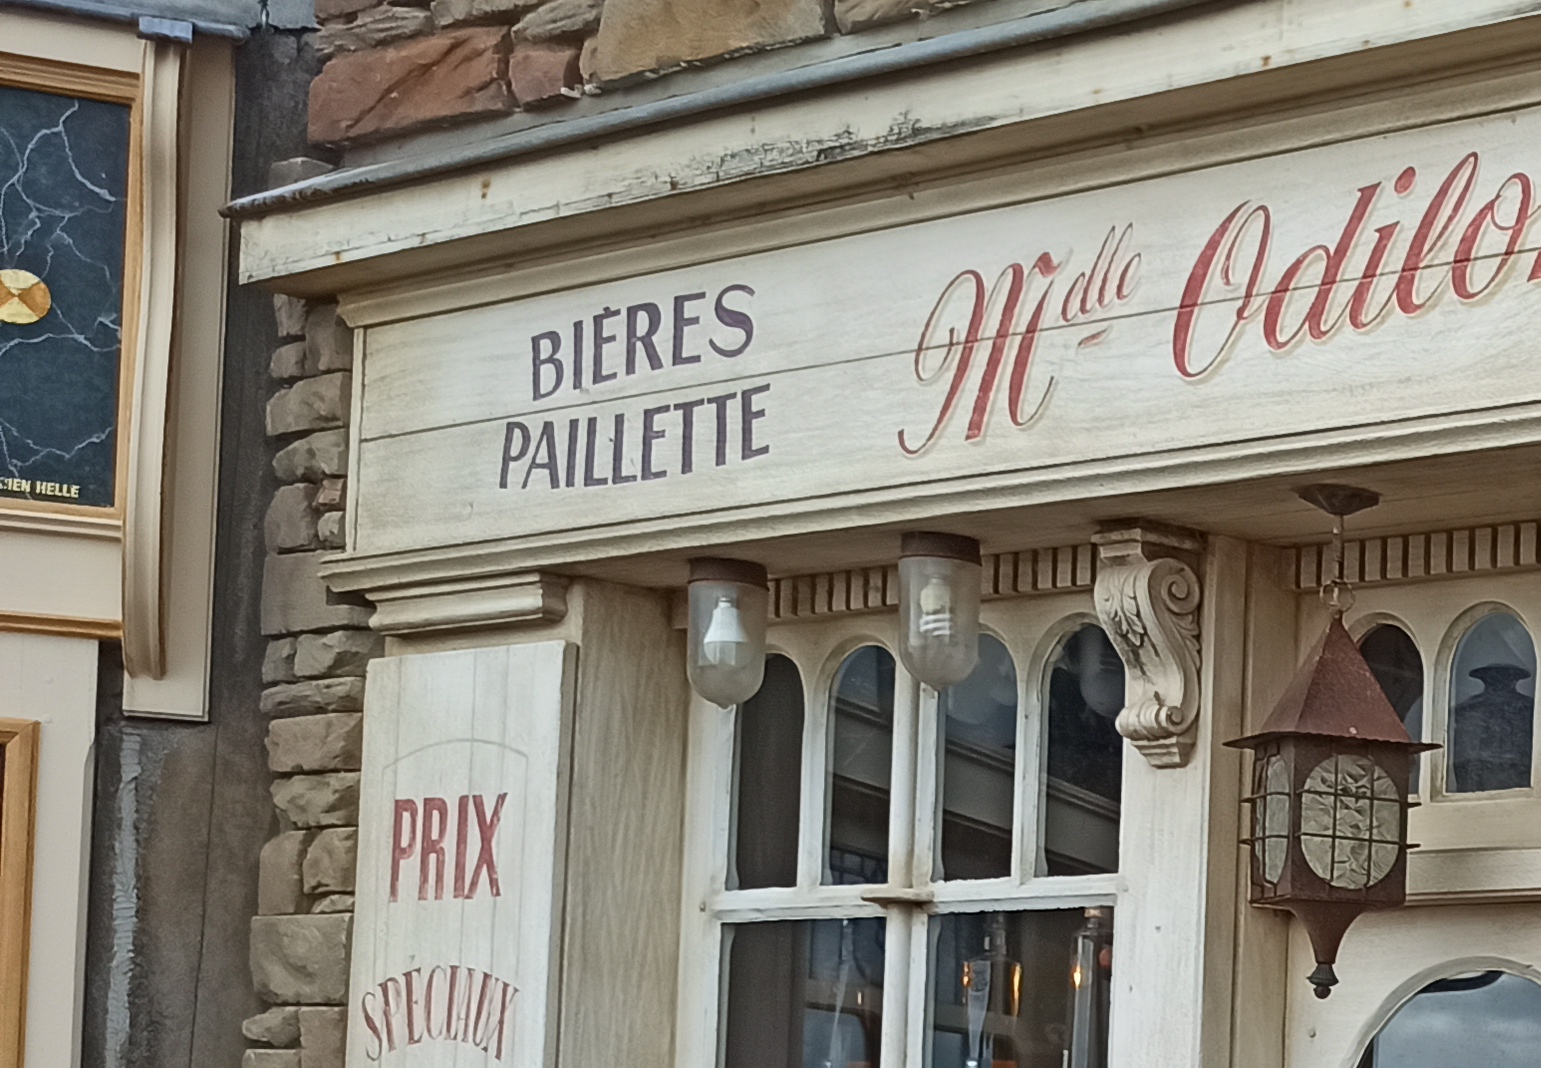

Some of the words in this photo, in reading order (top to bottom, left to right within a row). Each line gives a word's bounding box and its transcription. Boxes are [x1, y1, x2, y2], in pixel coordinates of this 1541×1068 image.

[530, 284, 757, 402] BIÈRES
[498, 384, 772, 491] PAILLETTE
[389, 792, 509, 903] PRIX
